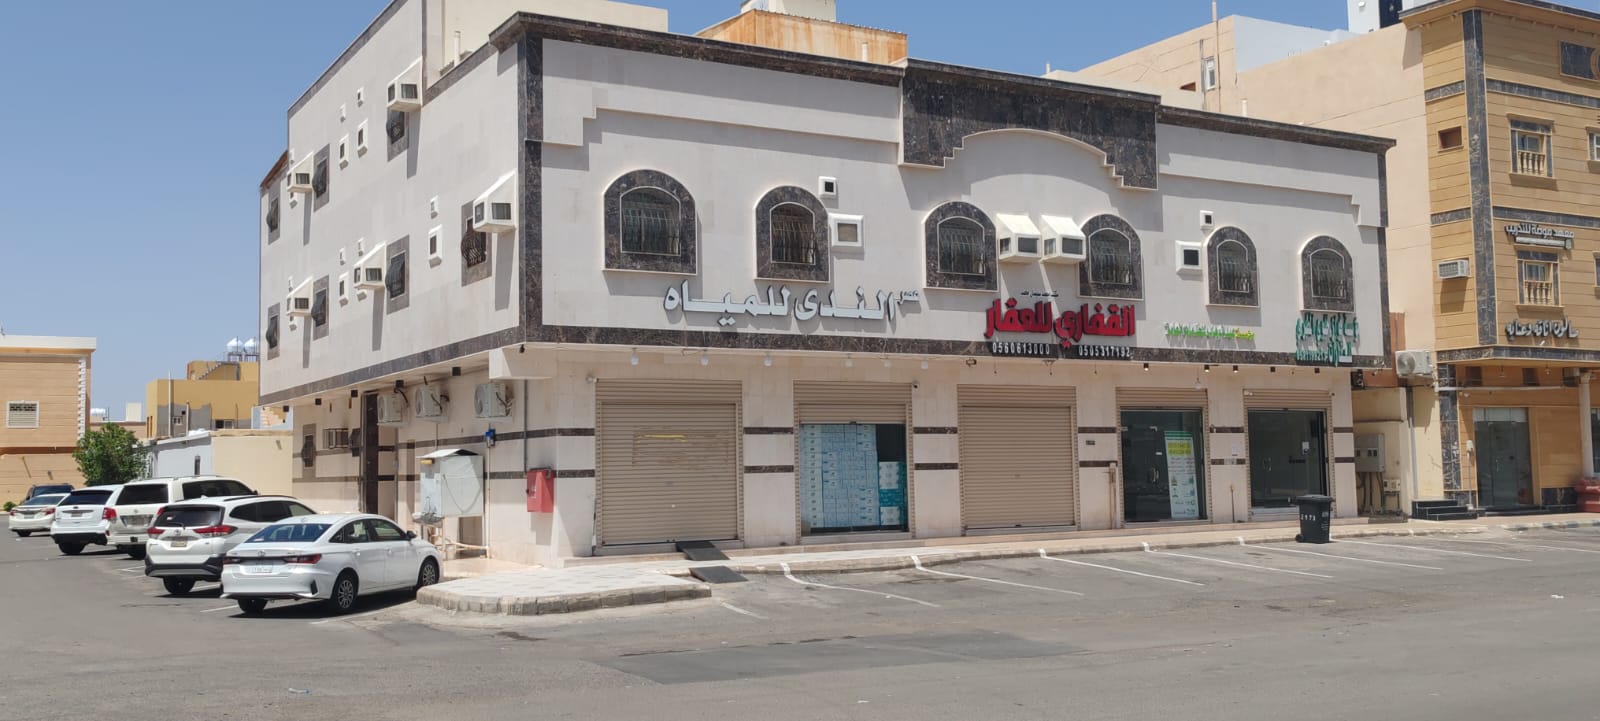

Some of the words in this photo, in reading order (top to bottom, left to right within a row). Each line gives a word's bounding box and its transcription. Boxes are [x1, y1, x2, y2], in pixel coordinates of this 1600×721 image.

[663, 279, 791, 327] للمياه
[794, 286, 896, 321] الندى
[984, 297, 1053, 340] للعقار
[1054, 303, 1135, 348] القفاري
[992, 341, 1050, 355] 0560613000
[1078, 345, 1131, 357] 0505317192
